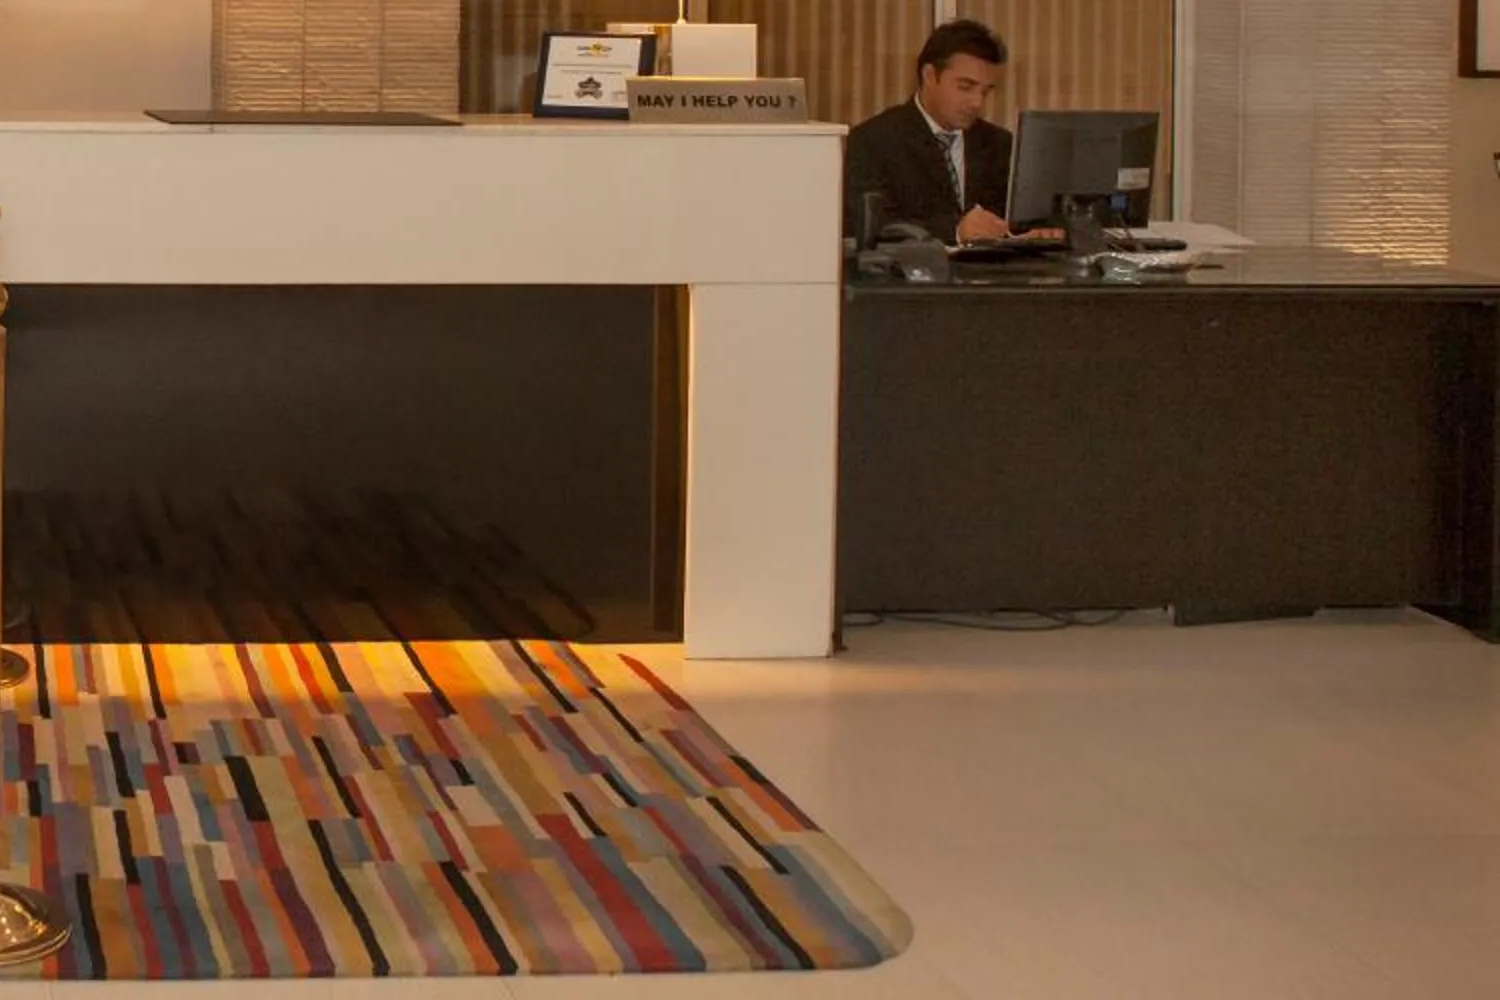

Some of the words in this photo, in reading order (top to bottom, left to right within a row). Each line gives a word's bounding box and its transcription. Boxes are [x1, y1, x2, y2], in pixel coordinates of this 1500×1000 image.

[636, 94, 675, 108] MAY
[680, 94, 687, 108] I
[692, 94, 738, 108] HELP
[743, 94, 781, 108] YOU
[787, 94, 797, 109] ?
